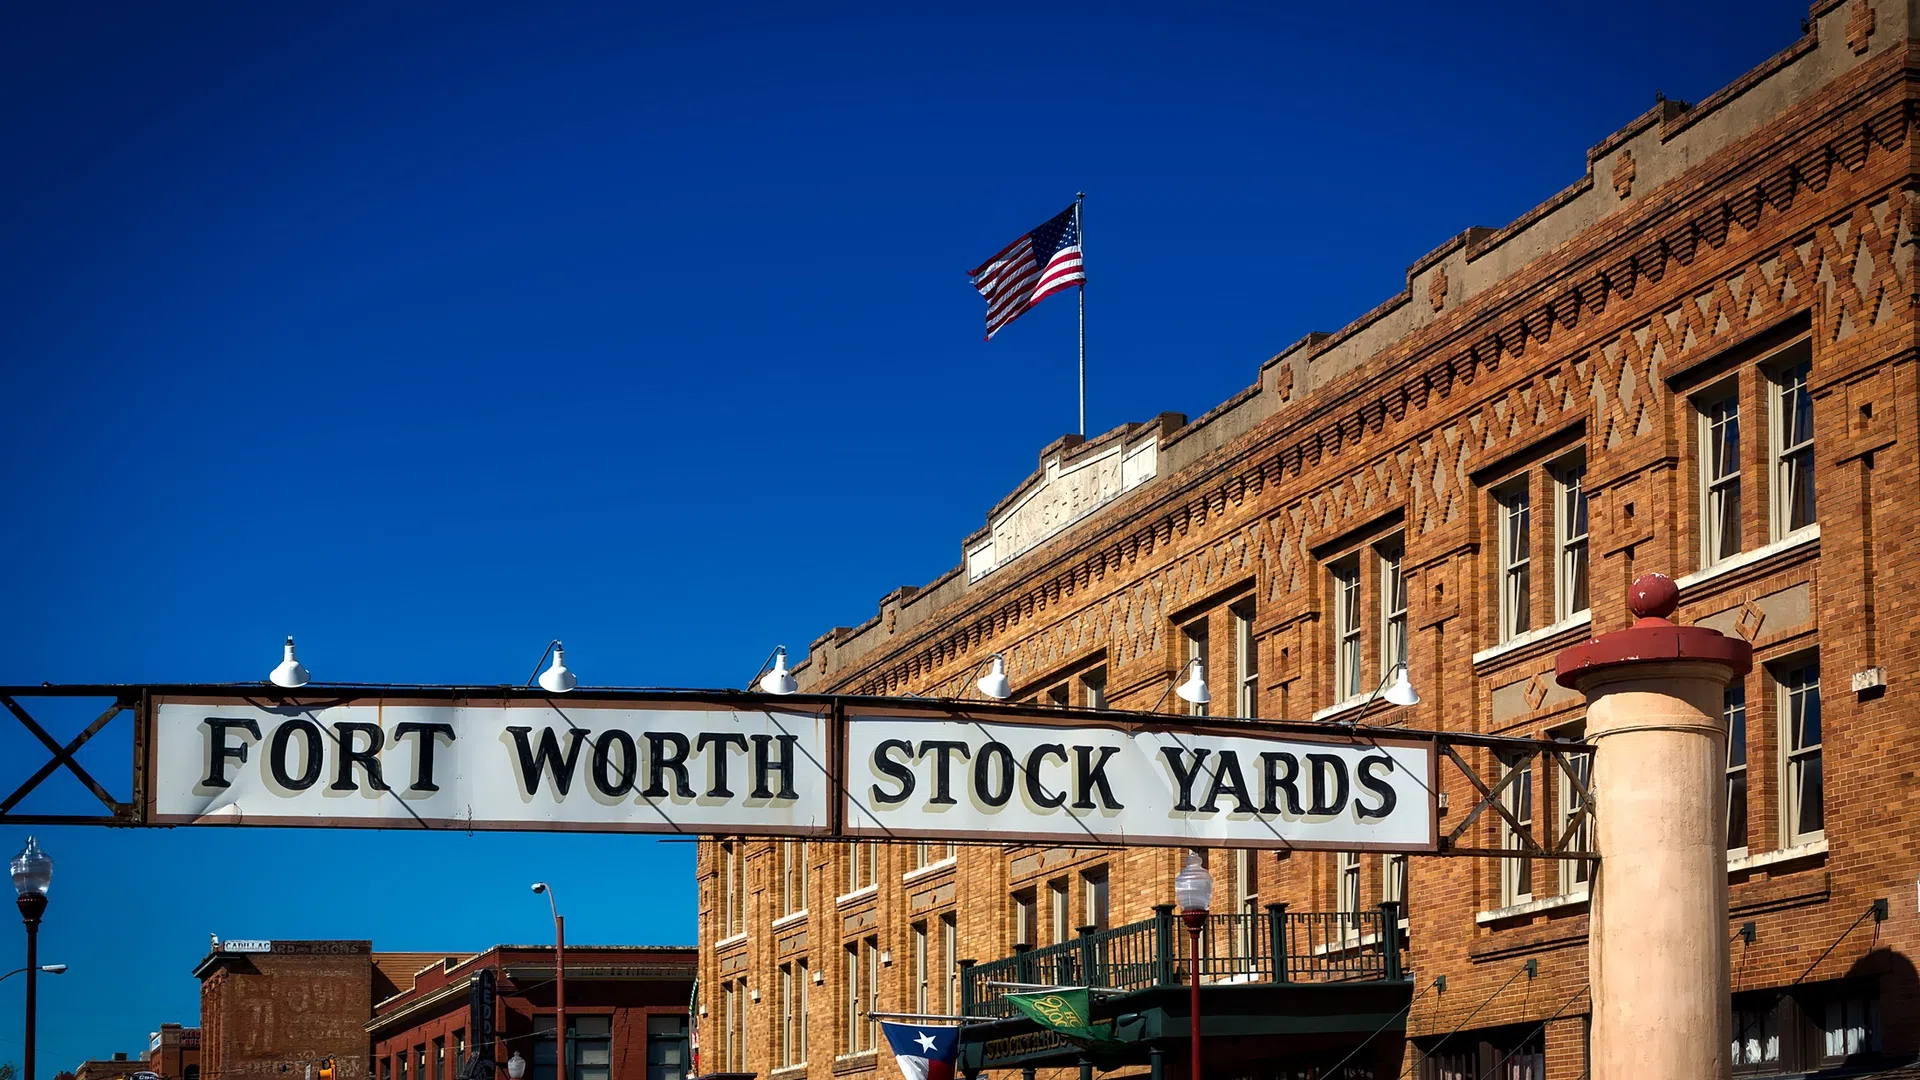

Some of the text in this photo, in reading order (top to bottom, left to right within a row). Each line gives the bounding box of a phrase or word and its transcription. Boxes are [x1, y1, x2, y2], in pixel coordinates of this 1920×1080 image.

[201, 716, 1398, 820] FORT WORTH STOCK YARDS
[986, 1029, 1068, 1060] STOCKYARDS
